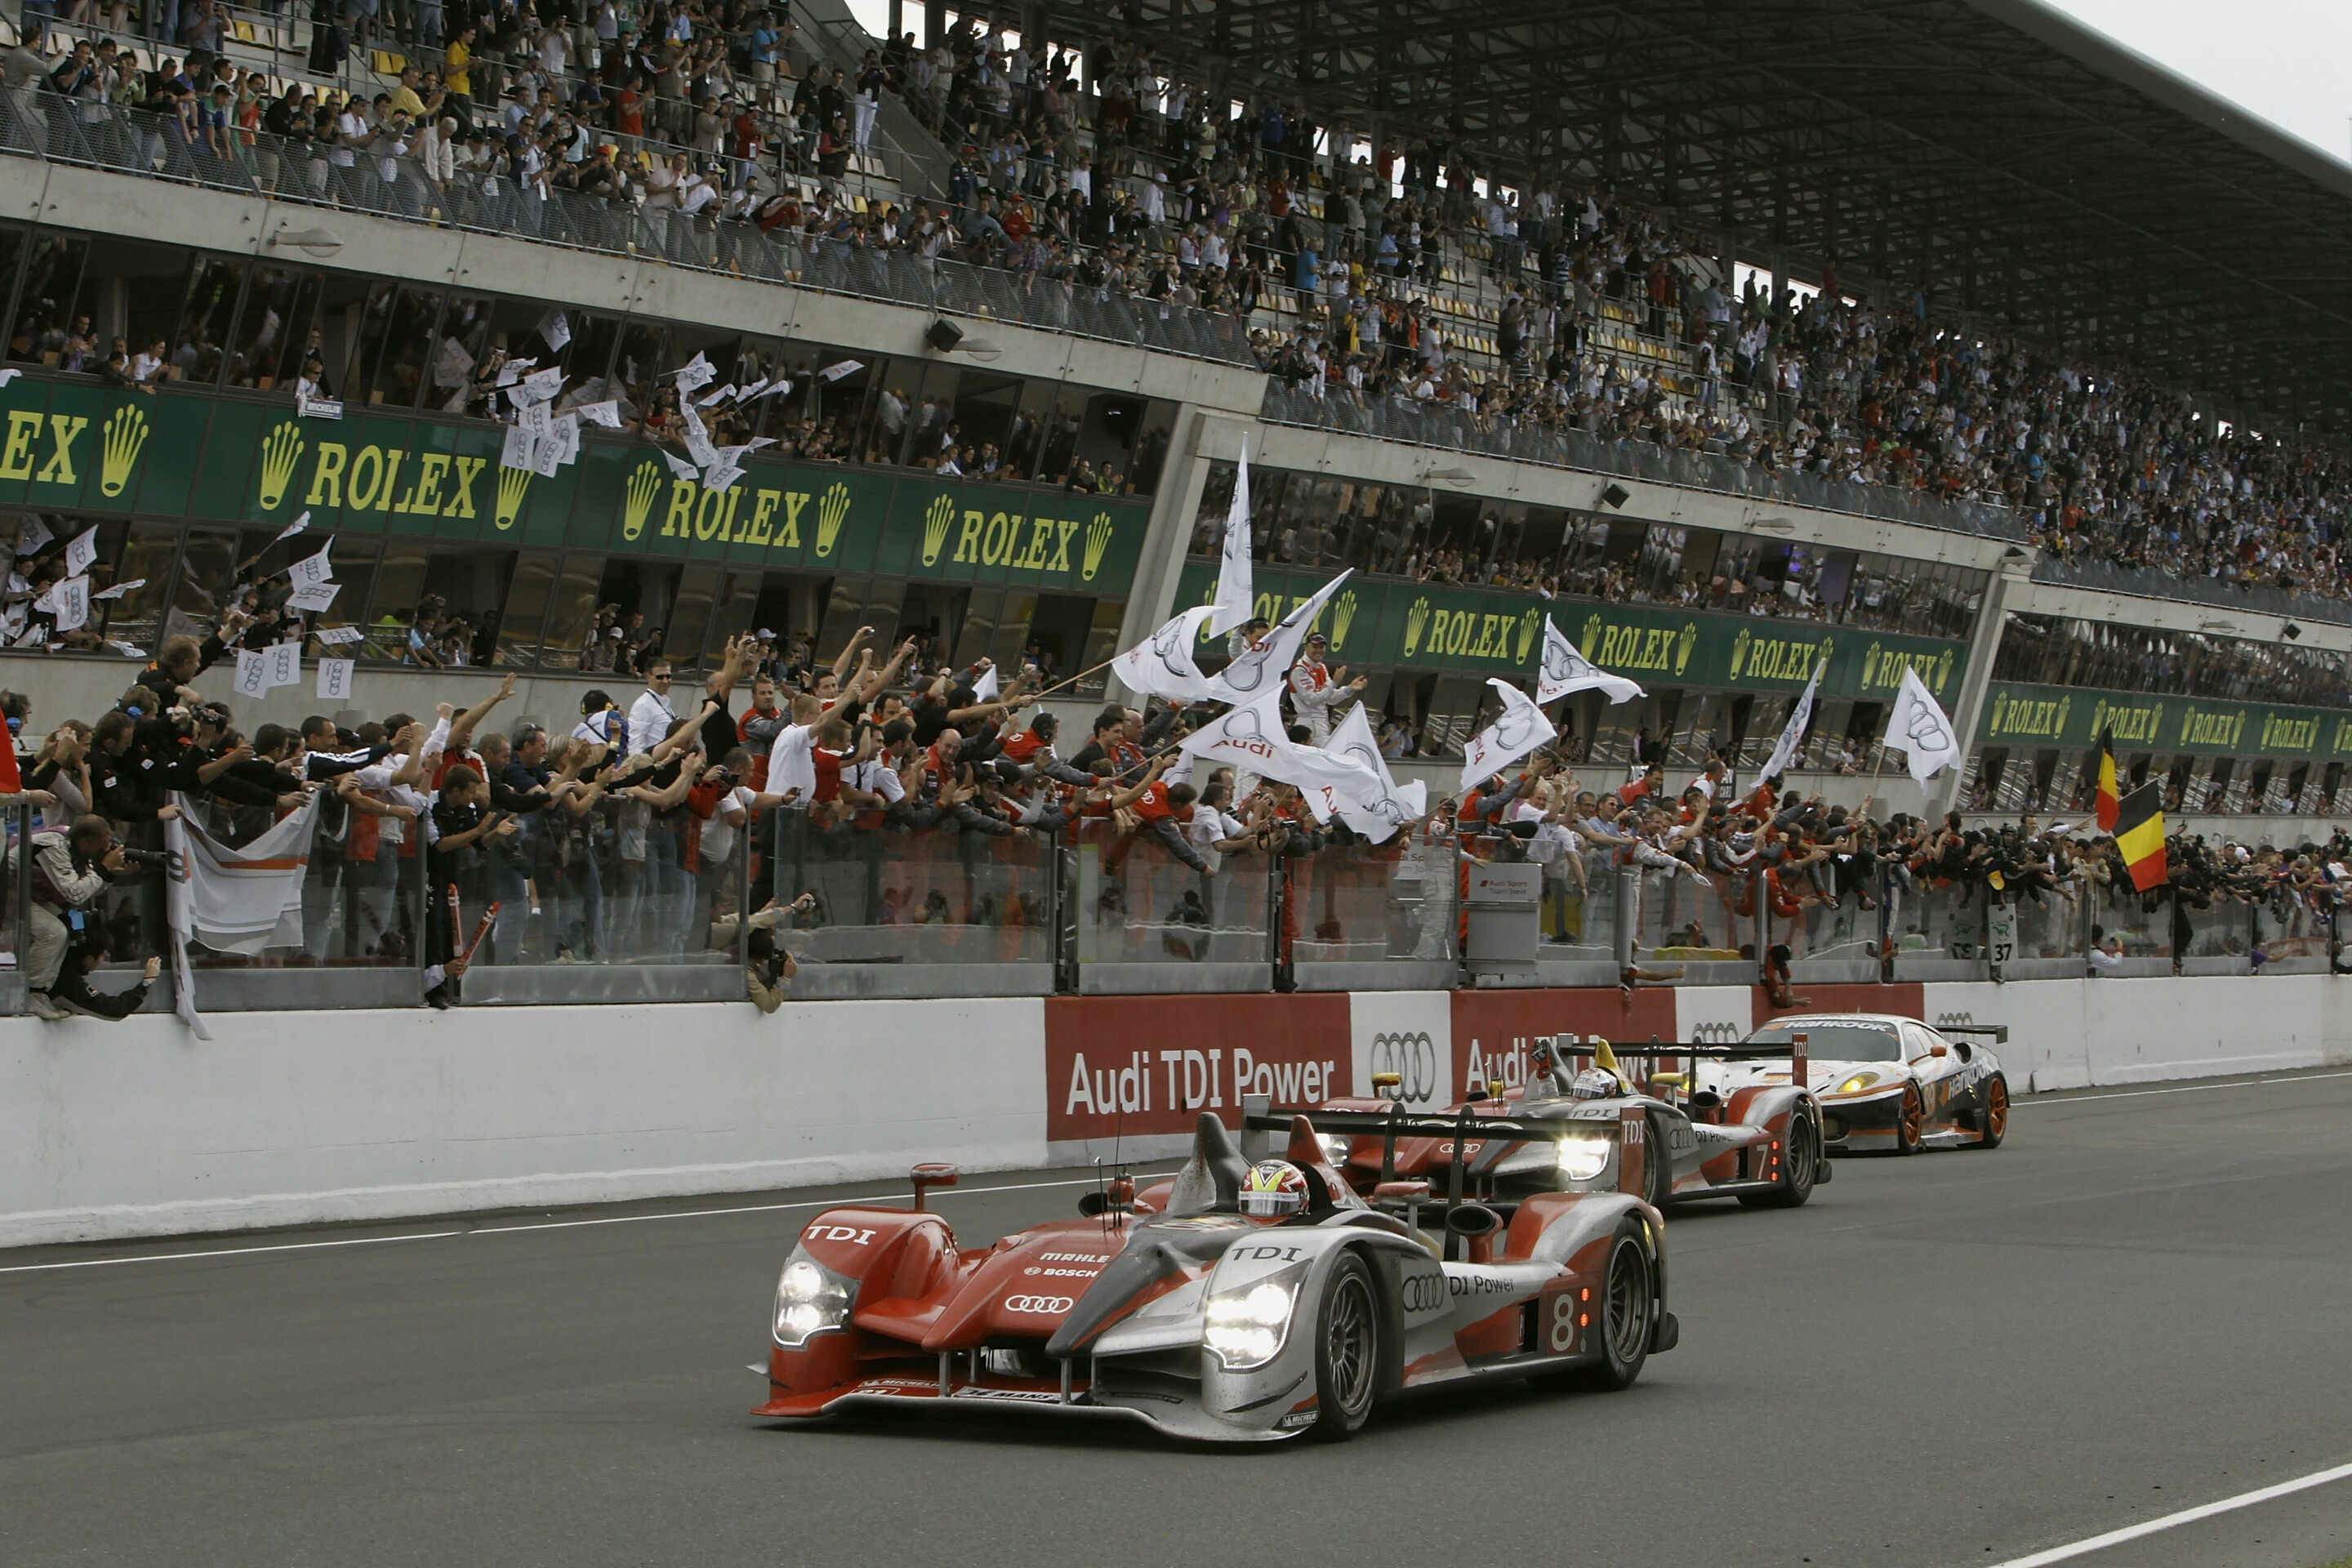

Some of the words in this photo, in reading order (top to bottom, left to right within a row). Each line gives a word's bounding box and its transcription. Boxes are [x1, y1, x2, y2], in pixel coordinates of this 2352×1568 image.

[0, 410, 88, 485] EX
[305, 442, 487, 519] ROLEX
[660, 479, 810, 548] ROLEX
[952, 510, 1080, 572] ROLEX
[1426, 609, 1517, 658] ROLEX
[1597, 625, 1677, 670] ROLEX
[1746, 639, 1816, 681] ROLEX
[2002, 699, 2057, 734] ROLEX
[2190, 713, 2234, 745] ROLEX
[1211, 739, 1275, 759] Audi
[2270, 719, 2310, 749] ROLEX
[1994, 942, 2012, 962] 37
[1466, 1037, 1526, 1093] Audi
[1793, 1042, 1807, 1057] TDI
[1066, 1051, 1151, 1115] Audi
[1160, 1049, 1223, 1110] TDI
[1234, 1048, 1334, 1107] Power
[1570, 1109, 1612, 1118] TDI
[1622, 1120, 1645, 1144] TDI
[1695, 1130, 1707, 1143] DI
[1757, 1144, 1768, 1180] 7
[807, 1226, 877, 1245] TDI
[1039, 1253, 1111, 1263] MAHLE
[1231, 1246, 1303, 1263] TDI
[1043, 1268, 1099, 1278] BOSCH
[1447, 1276, 1469, 1296] DI
[1474, 1275, 1514, 1295] Power
[1552, 1294, 1574, 1352] 8
